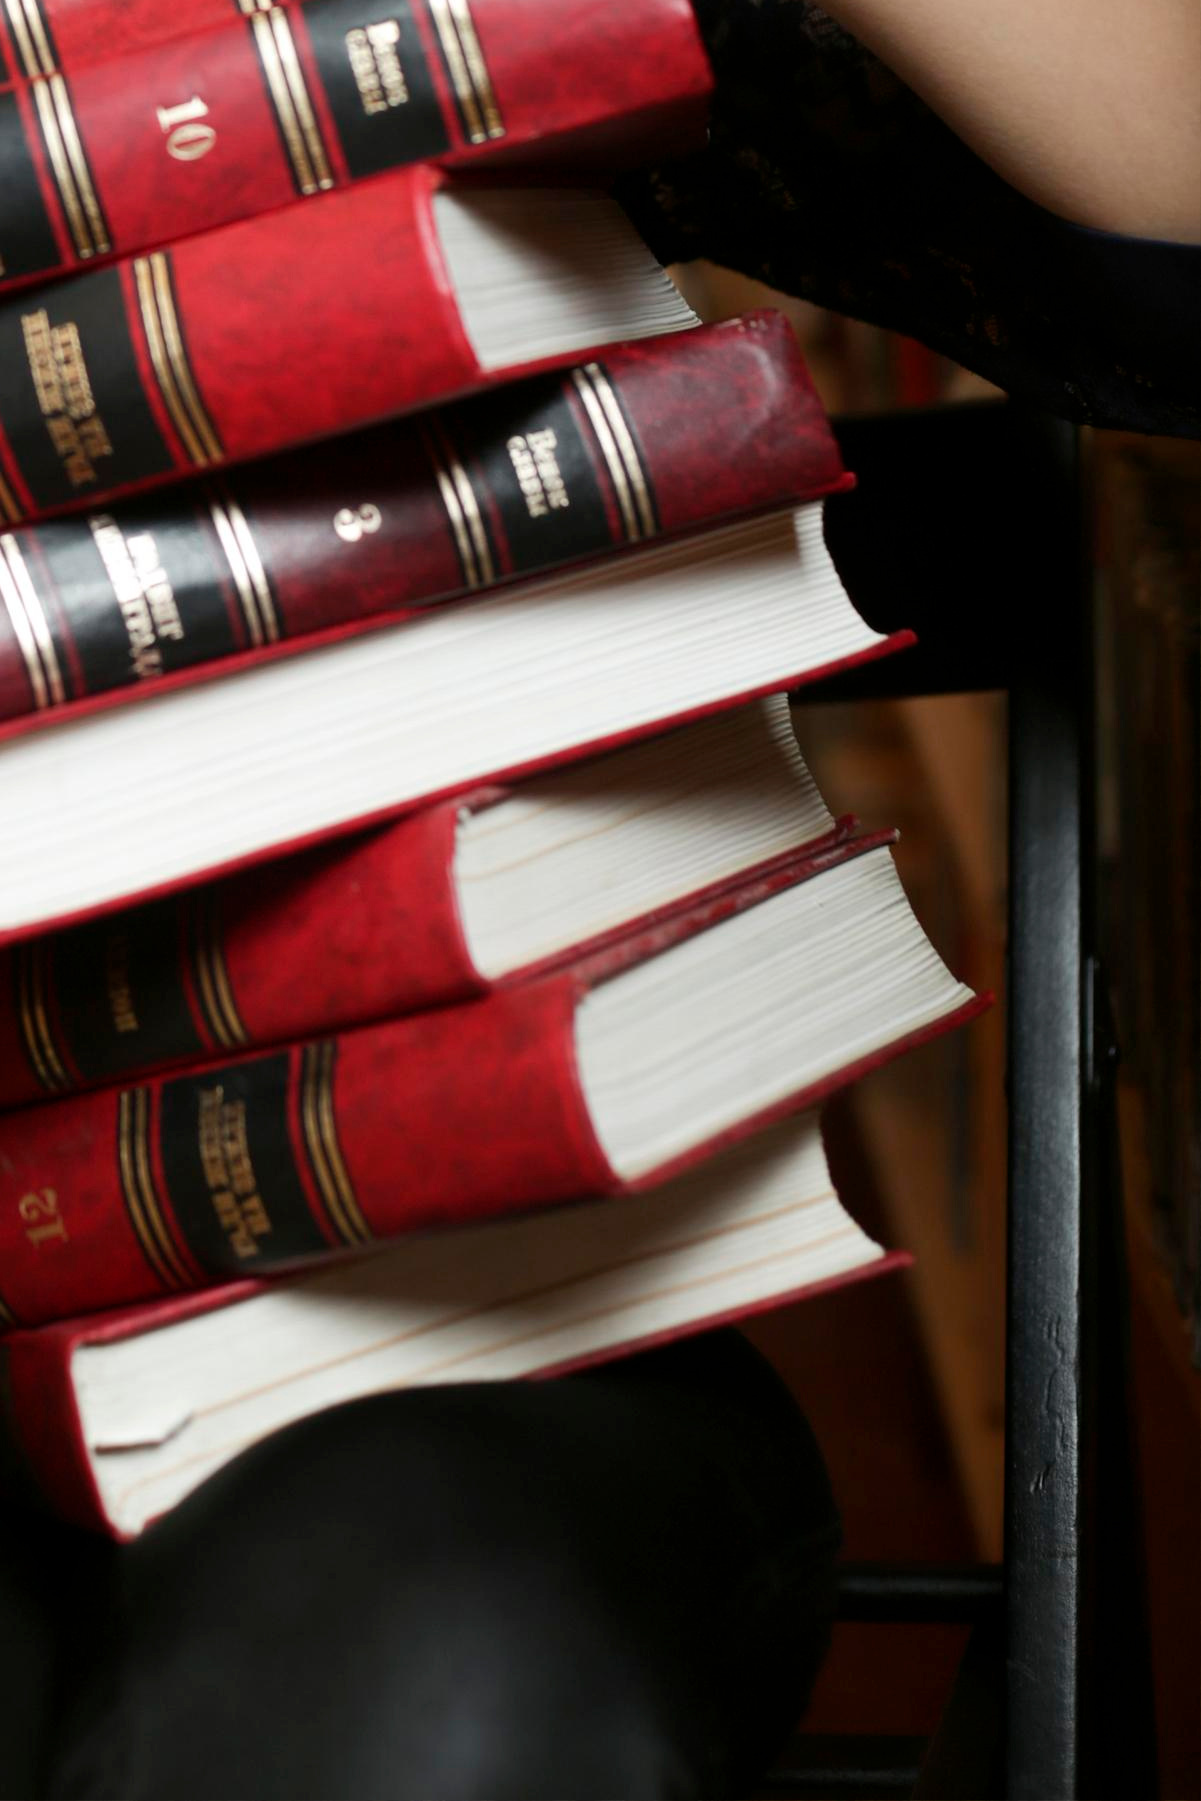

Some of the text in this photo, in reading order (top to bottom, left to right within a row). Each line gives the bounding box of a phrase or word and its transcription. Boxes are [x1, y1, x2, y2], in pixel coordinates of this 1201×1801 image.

[344, 28, 387, 114] славы
[156, 95, 216, 161] 10
[507, 434, 547, 517] славы
[526, 427, 569, 508] Венок
[333, 503, 382, 542] 3
[19, 1188, 69, 1249] 12
